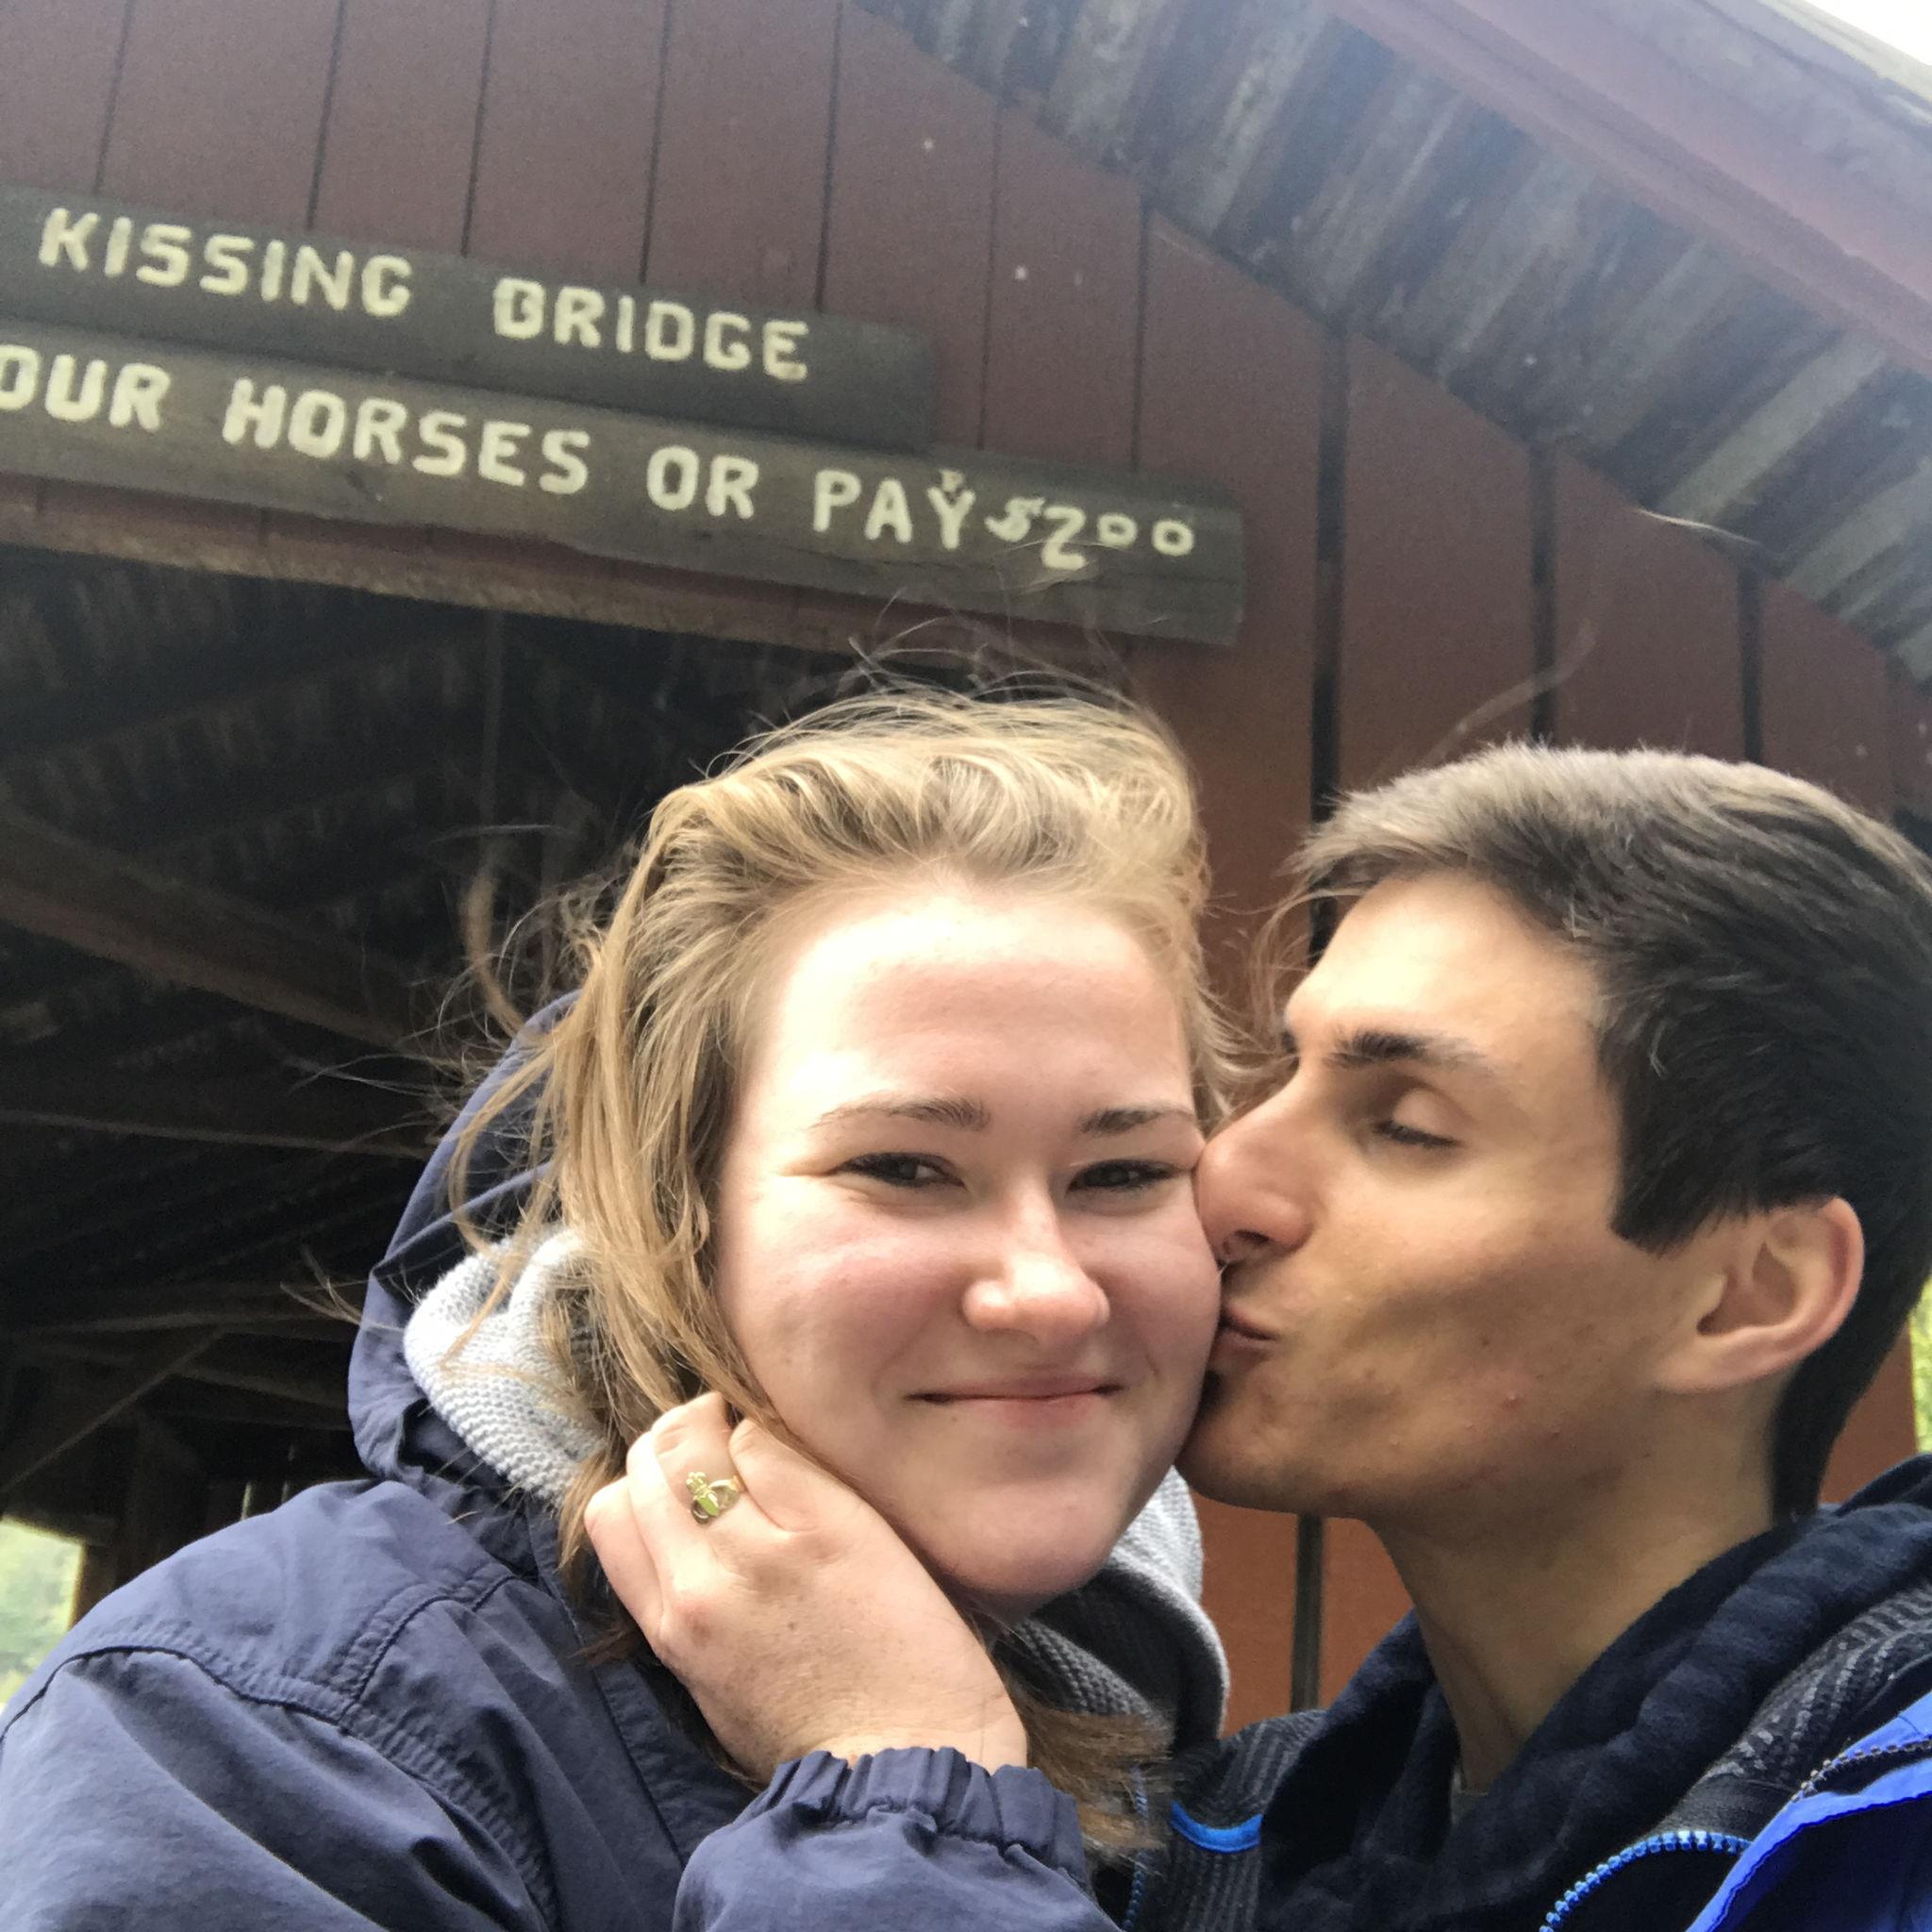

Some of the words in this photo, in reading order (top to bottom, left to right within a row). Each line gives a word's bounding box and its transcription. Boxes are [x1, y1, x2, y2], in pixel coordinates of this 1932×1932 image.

[38, 207, 413, 318] KISSING
[492, 276, 810, 382] BRIDGE
[222, 376, 592, 495] HORSES
[646, 444, 760, 520] OR
[811, 468, 977, 551] PAY
